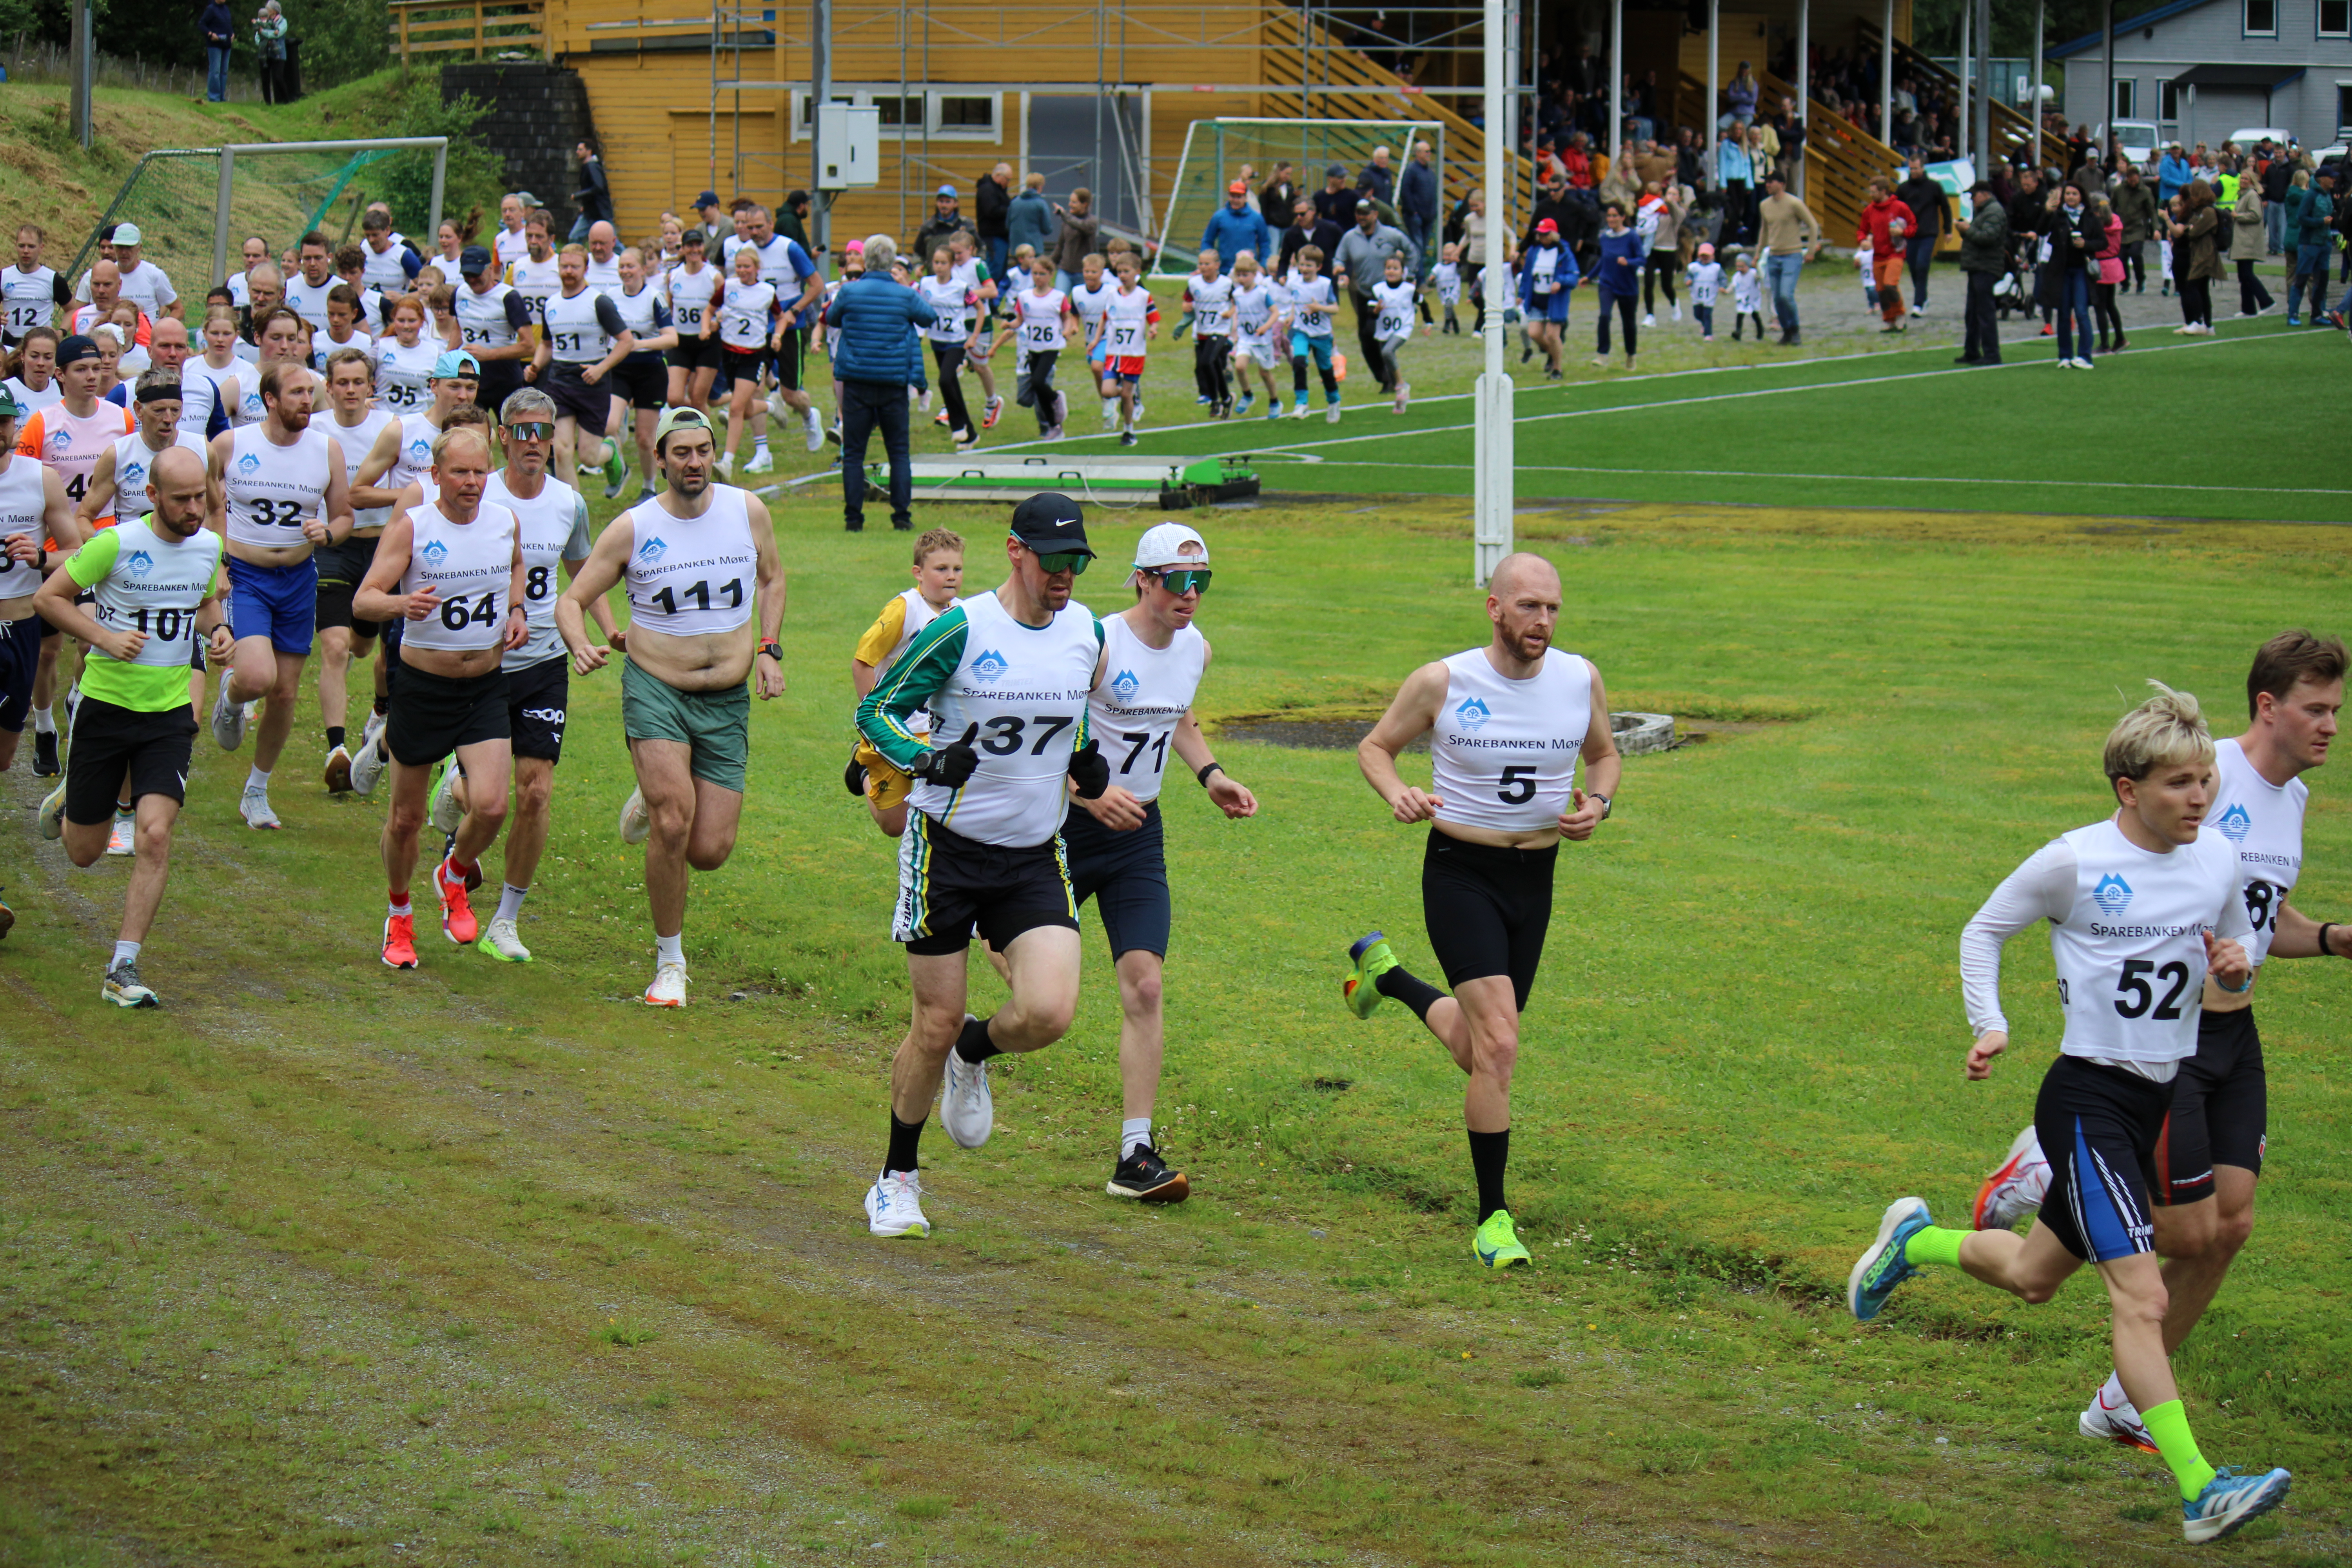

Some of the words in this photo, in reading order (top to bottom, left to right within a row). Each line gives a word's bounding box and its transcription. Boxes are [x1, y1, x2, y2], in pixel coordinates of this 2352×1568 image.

[523, 296, 548, 313] 69
[12, 308, 37, 326] 12
[678, 307, 701, 324] 36
[1200, 310, 1218, 325] 77
[1383, 316, 1401, 331] 90
[738, 319, 750, 335] 2
[1027, 325, 1053, 342] 126
[555, 333, 580, 350] 51
[1116, 328, 1135, 344] 57
[388, 385, 417, 406] 55
[232, 477, 295, 490] SPAREBANKEN
[299, 484, 322, 494] MØRE
[250, 498, 302, 526] 32
[421, 568, 487, 580] SPAREBANKEN
[636, 559, 715, 578] SPAREBANKEN
[719, 555, 751, 565] MØRE
[123, 581, 188, 592] SPAREBANKEN
[525, 566, 548, 601] 8
[652, 578, 742, 615] 111
[441, 592, 497, 631] 64
[128, 608, 198, 642] 107
[963, 687, 1062, 701] SPAREBANKEN
[1067, 690, 1089, 701] MØR
[1105, 703, 1173, 716] SPAREBANKEN
[981, 715, 1074, 756] 37
[1449, 734, 1546, 750] SPAREBANKEN
[1120, 731, 1170, 775] 71
[1497, 766, 1537, 805] 5
[2241, 852, 2290, 866] REBANKEN
[902, 886, 912, 929] TRIMTEX
[2091, 923, 2187, 937] SPAREBANKEN
[2114, 959, 2189, 1020] 52
